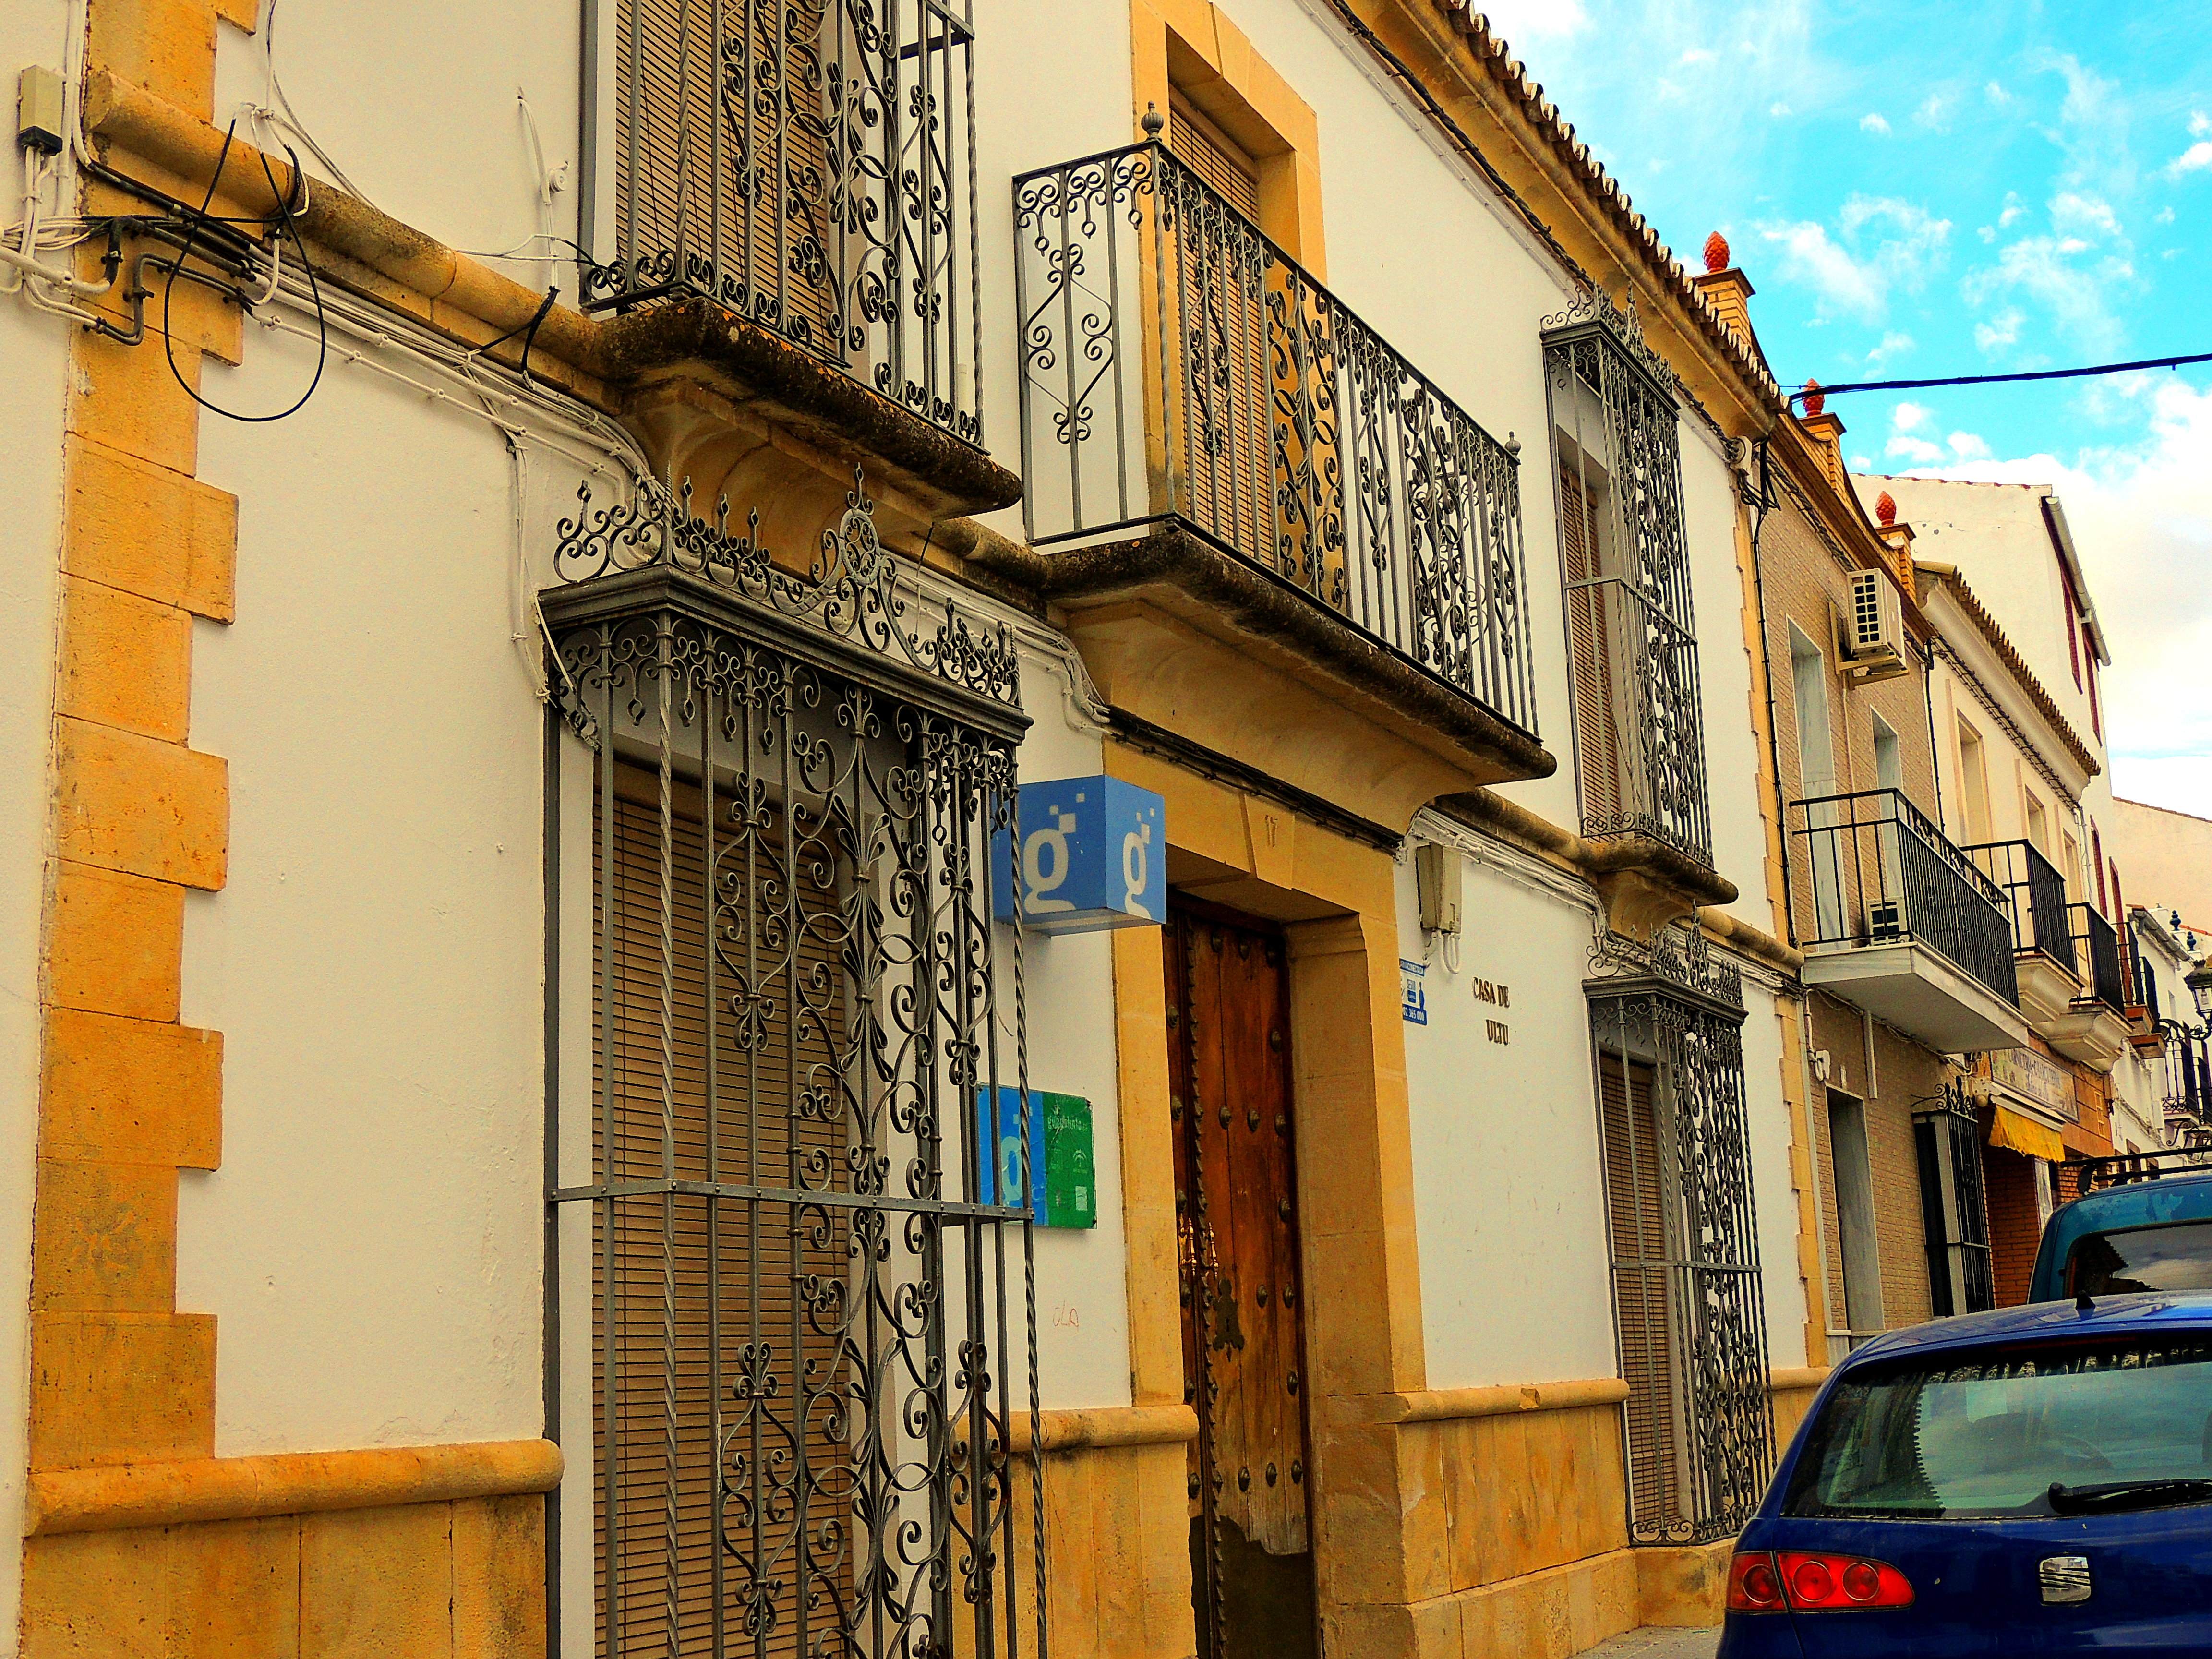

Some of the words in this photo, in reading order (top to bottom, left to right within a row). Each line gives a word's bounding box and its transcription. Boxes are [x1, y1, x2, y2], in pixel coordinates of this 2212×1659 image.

[1472, 976, 1496, 1004] CASA
[1496, 984, 1510, 1008] DE
[1486, 1019, 1509, 1046] ULTU
